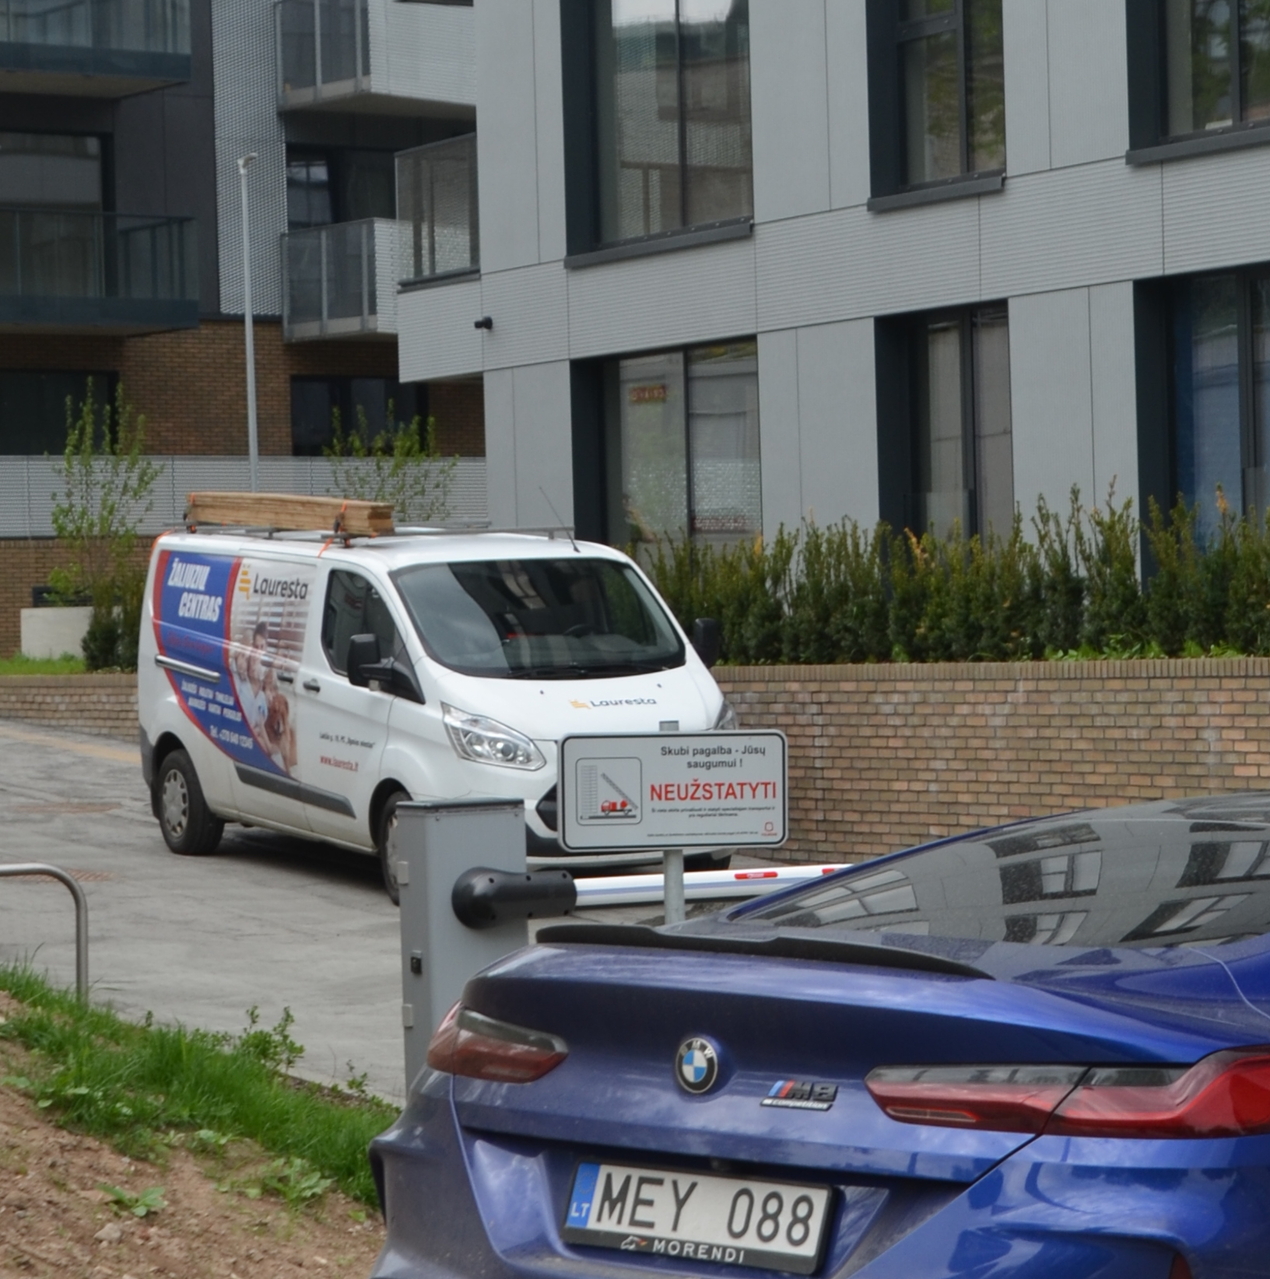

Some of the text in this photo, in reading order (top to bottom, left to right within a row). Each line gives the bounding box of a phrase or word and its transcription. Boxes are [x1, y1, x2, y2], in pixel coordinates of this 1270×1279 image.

[253, 572, 308, 600] Lauresta
[178, 591, 222, 621] CENTRAS
[590, 698, 657, 707] Lauresta
[660, 746, 689, 756] Skubi
[692, 745, 732, 757] pagalba
[741, 745, 766, 756] Jūsų
[687, 759, 737, 770] saugumui
[650, 778, 776, 801] NEUŽSTATYTI
[680, 1040, 713, 1059] BMW
[788, 1081, 839, 1102] M8
[571, 1203, 590, 1218] LT
[597, 1172, 814, 1247] MEY 088
[653, 1238, 745, 1263] MORENDI
